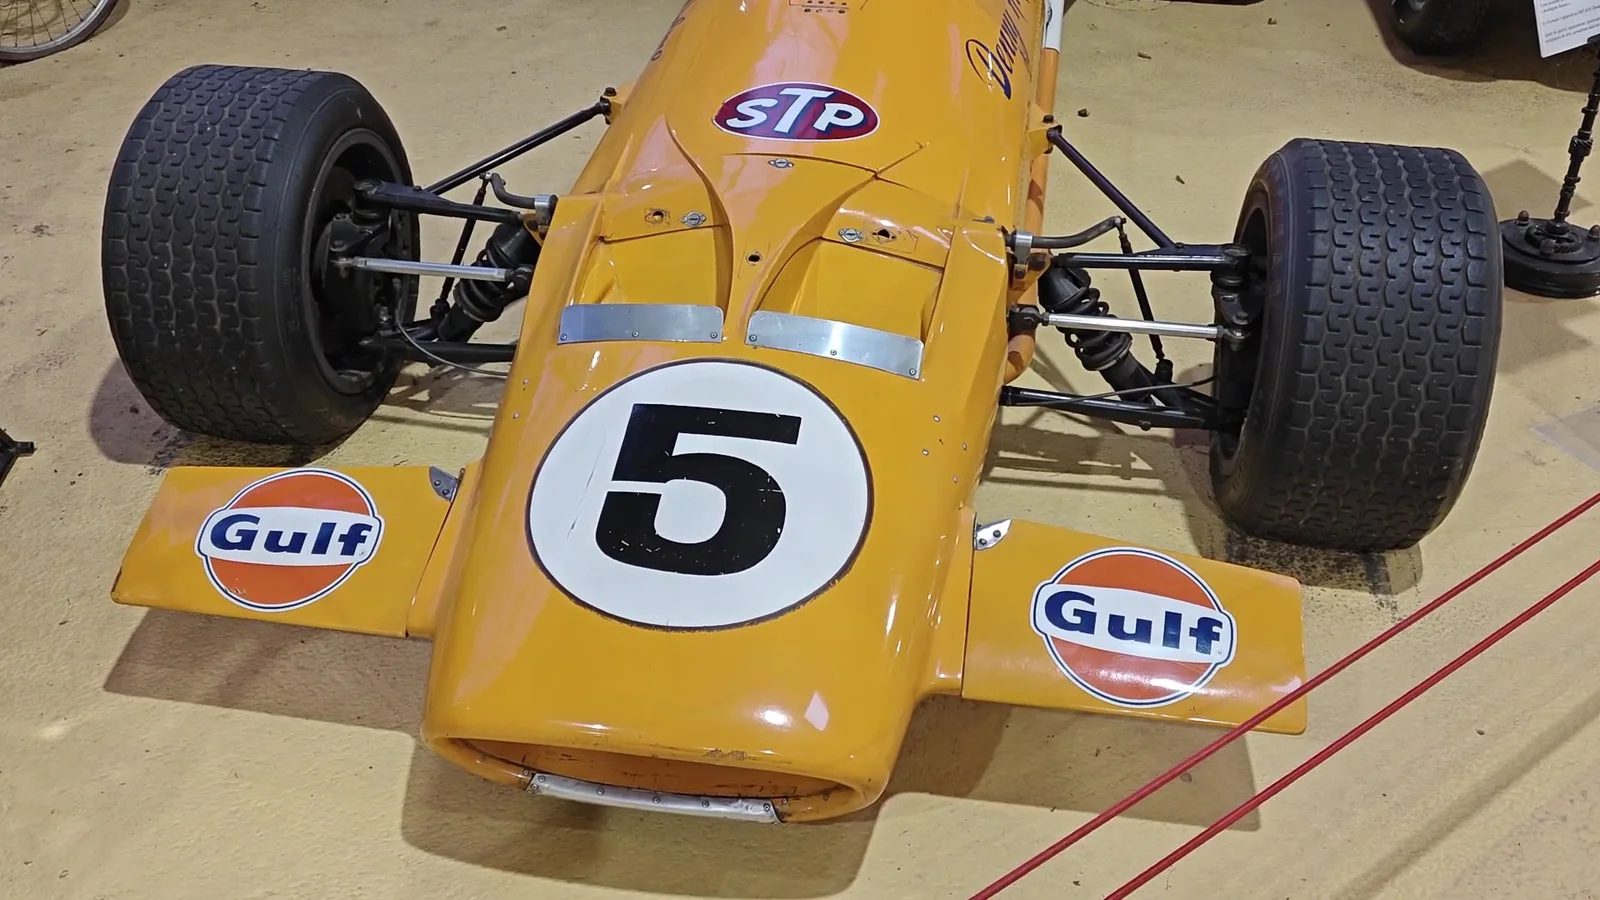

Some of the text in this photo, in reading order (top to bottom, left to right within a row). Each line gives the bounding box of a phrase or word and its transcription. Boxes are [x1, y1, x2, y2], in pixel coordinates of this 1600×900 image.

[726, 87, 865, 133] STP
[595, 403, 802, 576] 5
[210, 513, 373, 556] Gulf
[1044, 590, 1223, 655] Gulf
